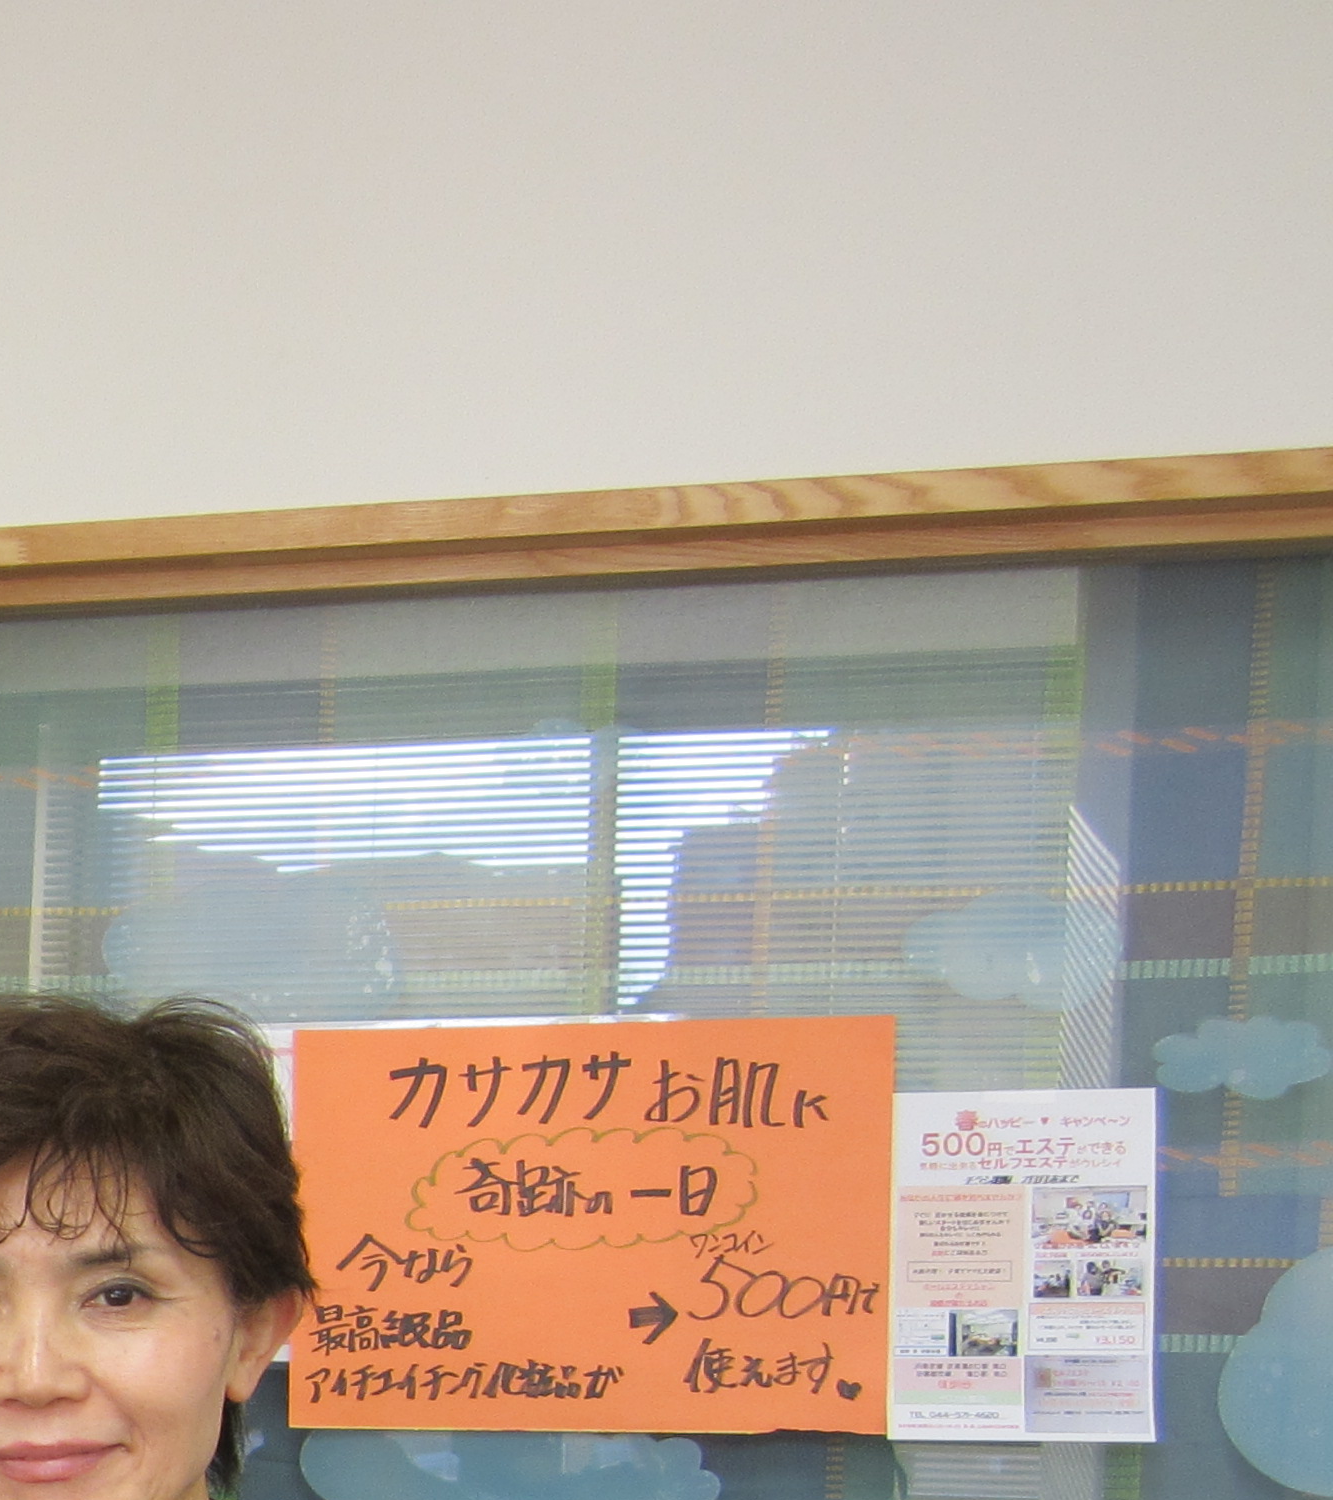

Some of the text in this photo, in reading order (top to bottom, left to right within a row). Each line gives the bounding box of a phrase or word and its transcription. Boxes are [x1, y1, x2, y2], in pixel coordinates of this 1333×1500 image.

[336, 1233, 473, 1291] 今なら
[309, 1304, 473, 1356] 最高級品
[683, 1338, 833, 1394] 使えます
